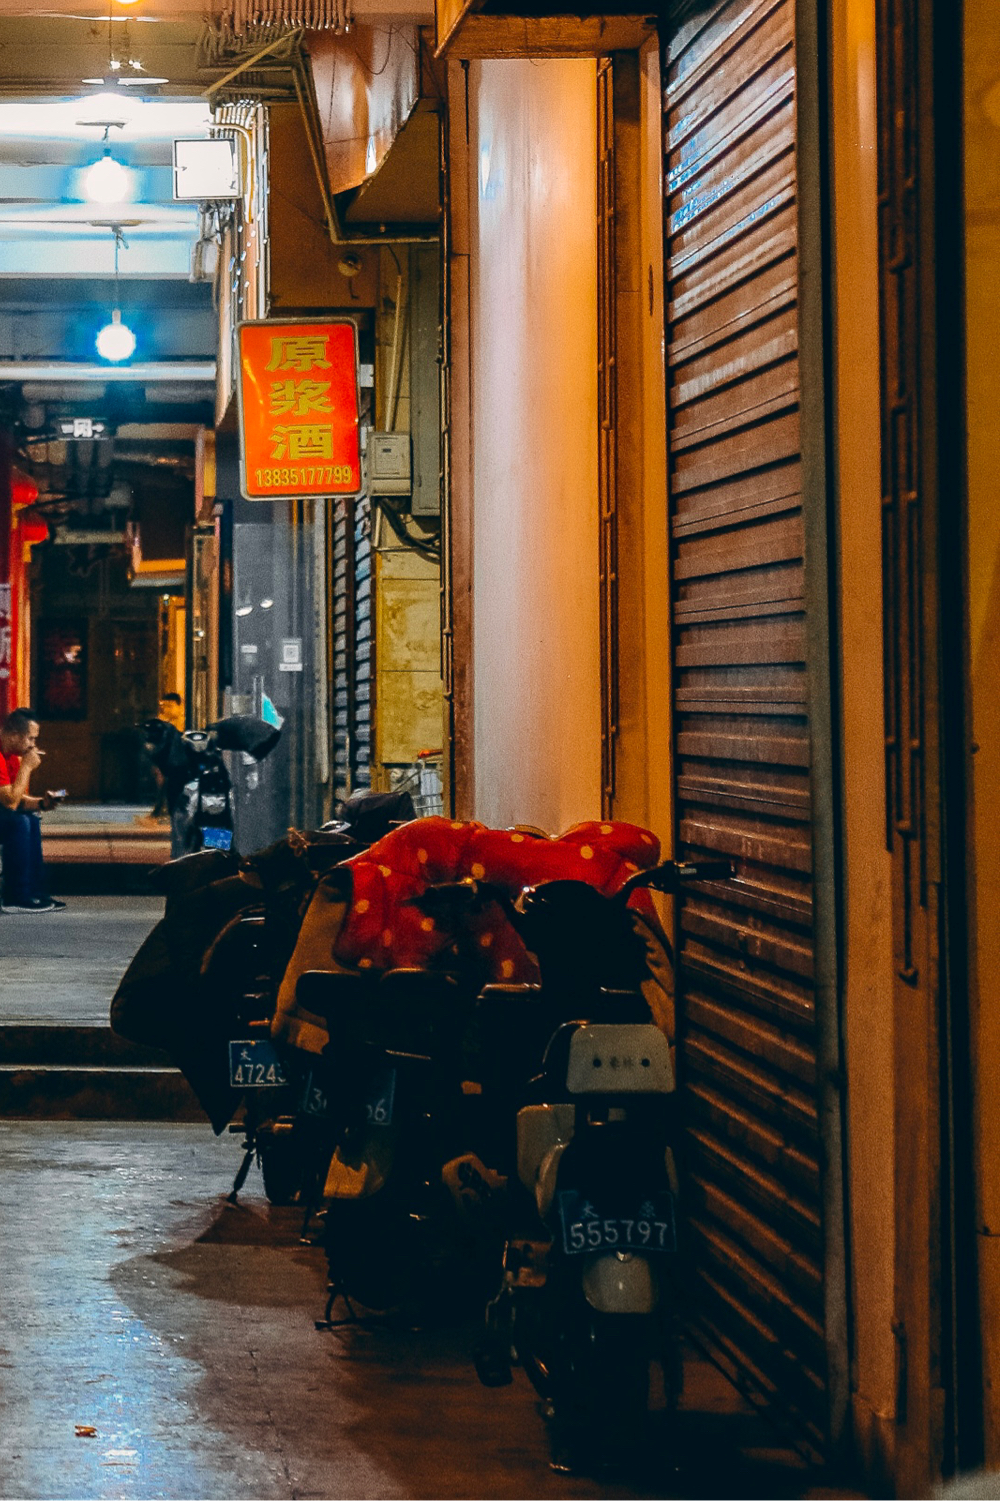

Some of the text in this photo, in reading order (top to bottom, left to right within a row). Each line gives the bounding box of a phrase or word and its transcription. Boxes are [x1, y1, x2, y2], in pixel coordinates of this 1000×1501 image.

[265, 335, 335, 461] 原浆酒
[255, 465, 353, 487] 13835177799
[570, 1219, 667, 1249] 555797
